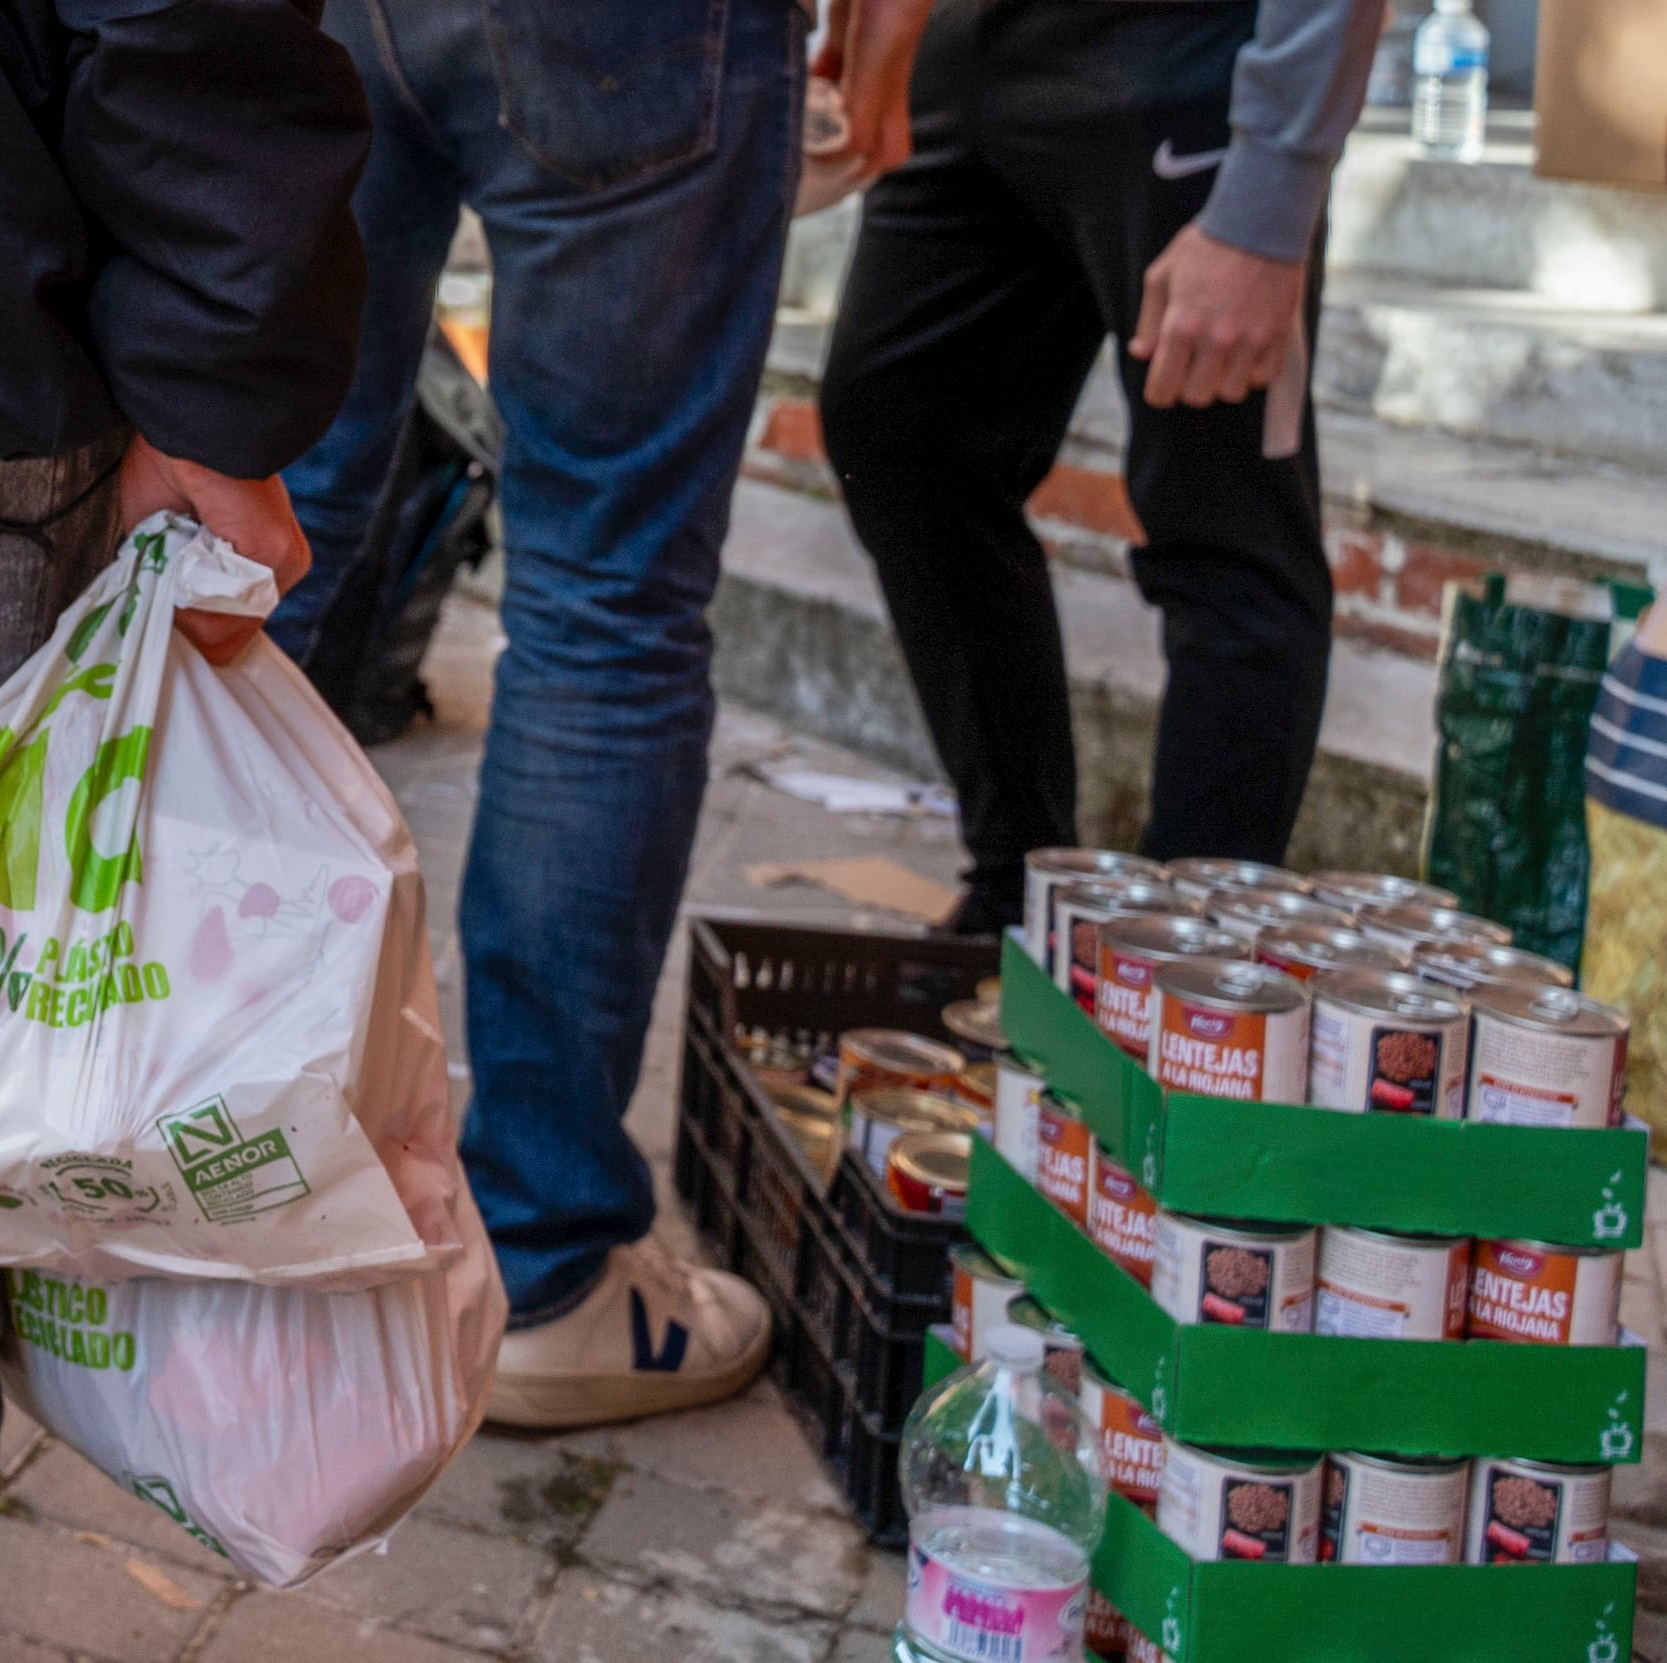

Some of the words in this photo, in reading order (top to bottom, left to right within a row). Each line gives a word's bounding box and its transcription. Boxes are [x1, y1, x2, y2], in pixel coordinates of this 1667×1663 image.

[1162, 1029, 1258, 1079] LENTEJAS
[194, 1139, 278, 1186] AENOR
[1474, 1266, 1567, 1320] ENTEJAS
